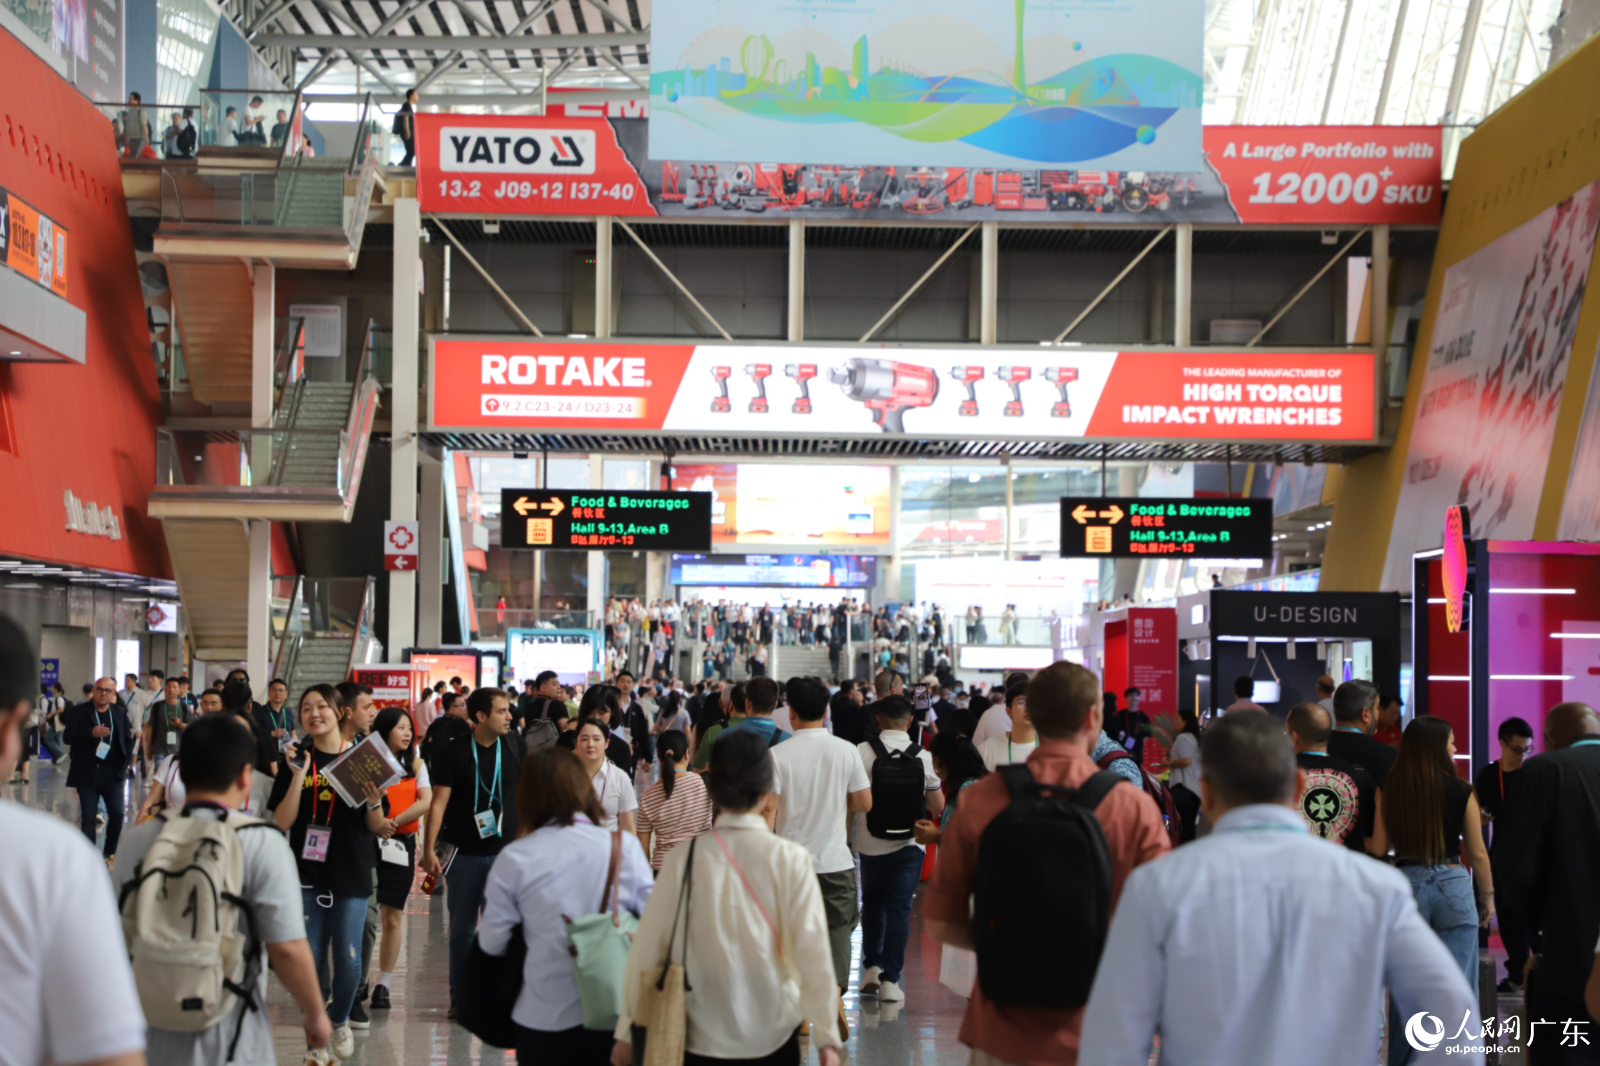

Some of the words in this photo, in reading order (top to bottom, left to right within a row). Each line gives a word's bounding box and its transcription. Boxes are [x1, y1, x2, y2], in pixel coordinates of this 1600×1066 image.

[449, 135, 541, 165] YATO
[1222, 143, 1237, 158] A
[1241, 143, 1297, 161] Large
[1300, 143, 1387, 158] Portfolio
[1389, 143, 1434, 158] with
[438, 180, 481, 197] 13.2
[494, 181, 563, 199] J09-12
[570, 183, 634, 200] I37-40
[1382, 185, 1433, 204] SKU
[481, 355, 646, 387] ROTAKE
[1182, 367, 1202, 377] THE
[1203, 368, 1246, 378] LEADING
[1247, 368, 1326, 379] MANUFACTURER
[1327, 369, 1342, 378] OF
[1183, 384, 1242, 402] HIGH
[1246, 384, 1342, 403] TORQUE
[502, 401, 522, 412] 9.2
[525, 401, 572, 413] C23-24
[585, 403, 632, 414] D23-24
[1122, 405, 1210, 424] IMPACT
[1213, 407, 1342, 426] WRENCHES
[571, 495, 605, 508] Food
[607, 495, 618, 508] &
[619, 496, 690, 511] Beverages
[1130, 503, 1165, 516] Food
[1166, 503, 1178, 516] &
[1179, 504, 1251, 519] Beverages
[571, 507, 606, 519] 餐饮区
[571, 522, 596, 534] Hall
[659, 523, 669, 535] B
[1129, 530, 1155, 542] Hall
[1219, 531, 1230, 543] B
[1254, 606, 1358, 623] U-DESIGN
[359, 672, 388, 687] BEE
